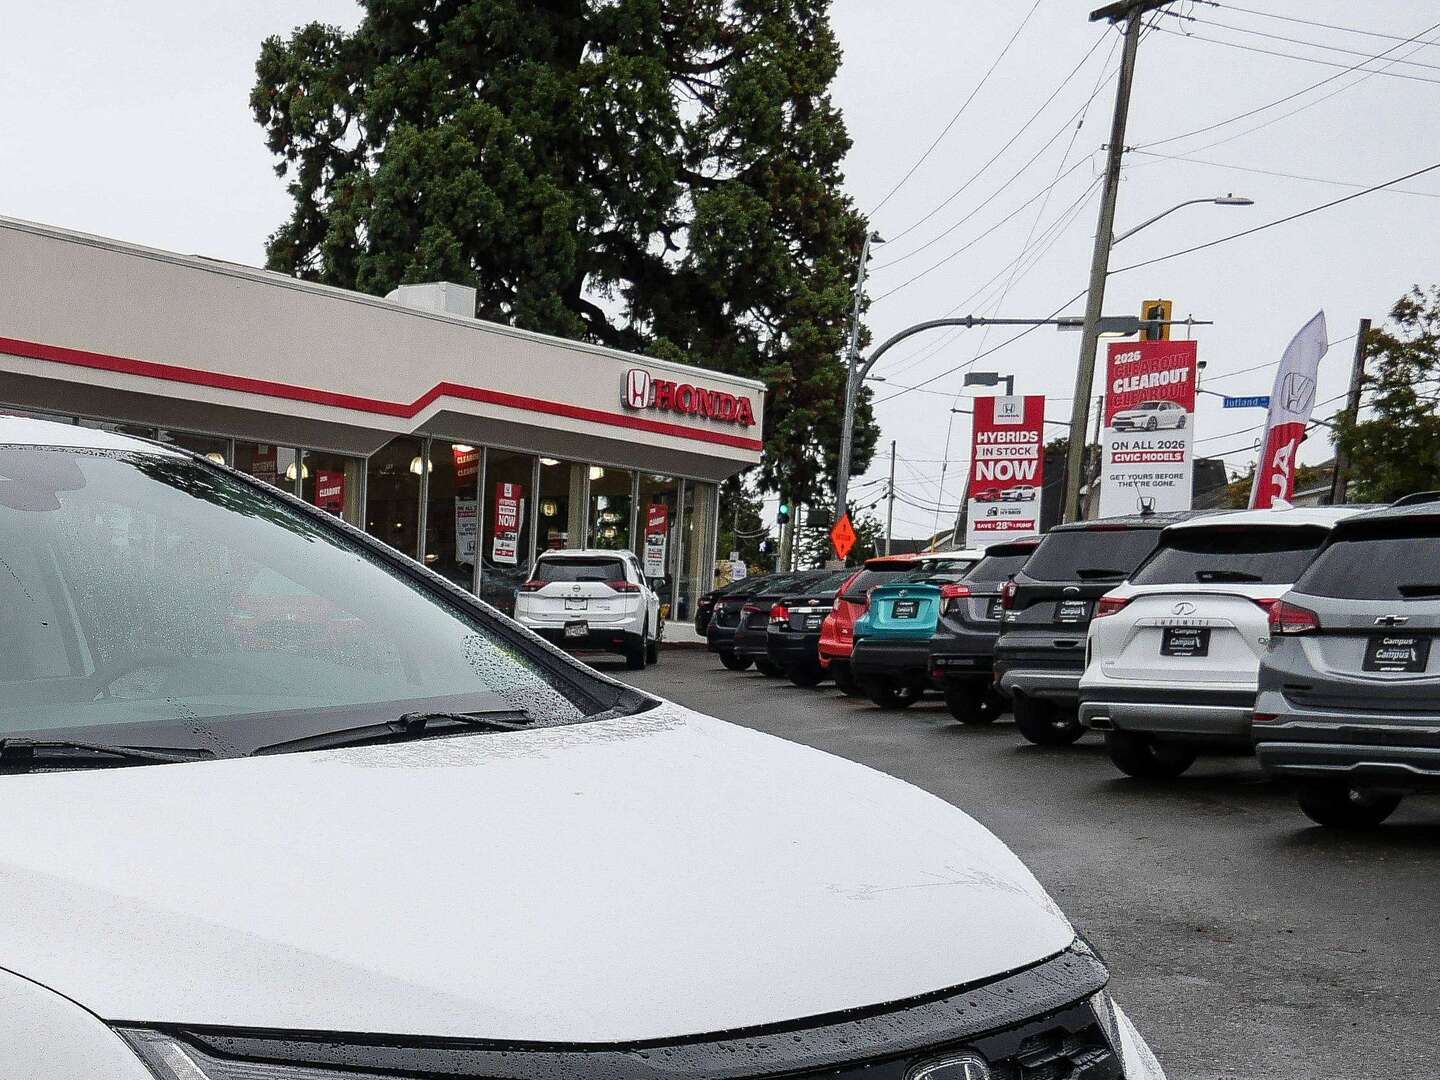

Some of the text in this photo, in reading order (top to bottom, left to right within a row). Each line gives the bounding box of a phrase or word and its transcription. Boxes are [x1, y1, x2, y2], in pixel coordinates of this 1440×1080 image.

[1114, 351, 1142, 365] 2026
[1113, 367, 1189, 394] CLEAROUT
[653, 379, 756, 426] HONDA
[1226, 398, 1258, 408] Jutland
[977, 430, 1039, 443] HYBRIDS
[1112, 440, 1185, 450] ON ALL 2026
[982, 447, 1031, 456] IN STOCK
[1114, 452, 1181, 462] CIVIC MODELS
[975, 460, 1038, 480] NOW
[1128, 473, 1153, 481] YOURS
[499, 515, 515, 526] NOW
[1383, 637, 1413, 645] Campus
[1376, 649, 1409, 660] Campus
